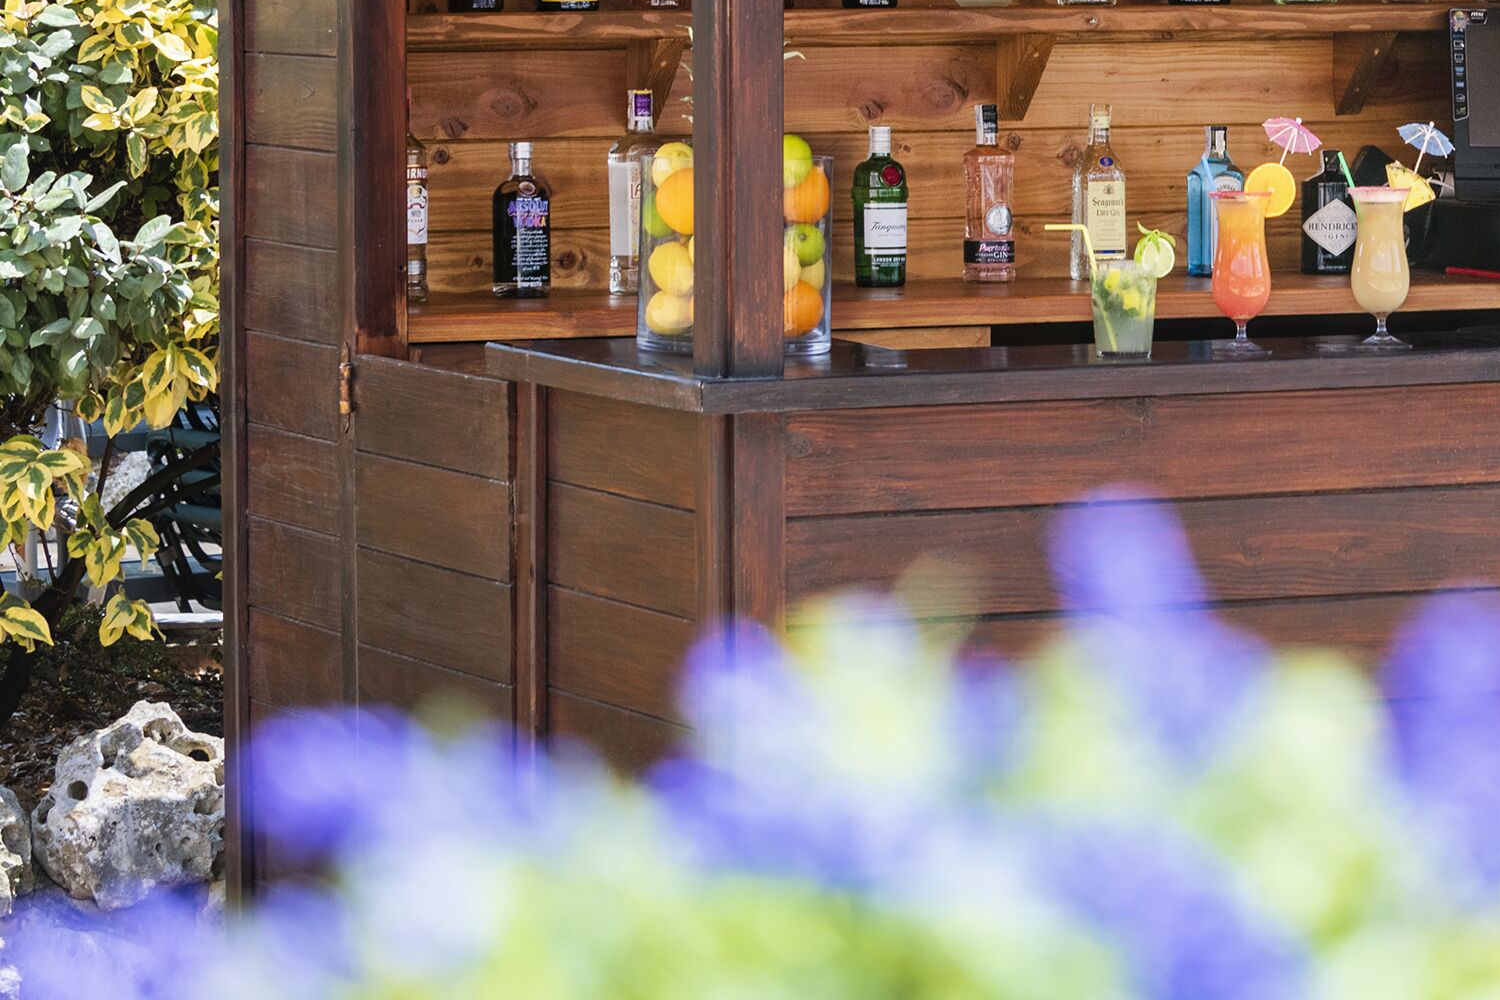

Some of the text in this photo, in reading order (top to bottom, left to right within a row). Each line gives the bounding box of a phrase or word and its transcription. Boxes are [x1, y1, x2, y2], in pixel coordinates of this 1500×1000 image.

[507, 200, 549, 212] ABSOLUT
[1092, 197, 1124, 208] Seagram's
[512, 215, 547, 228] VODKA
